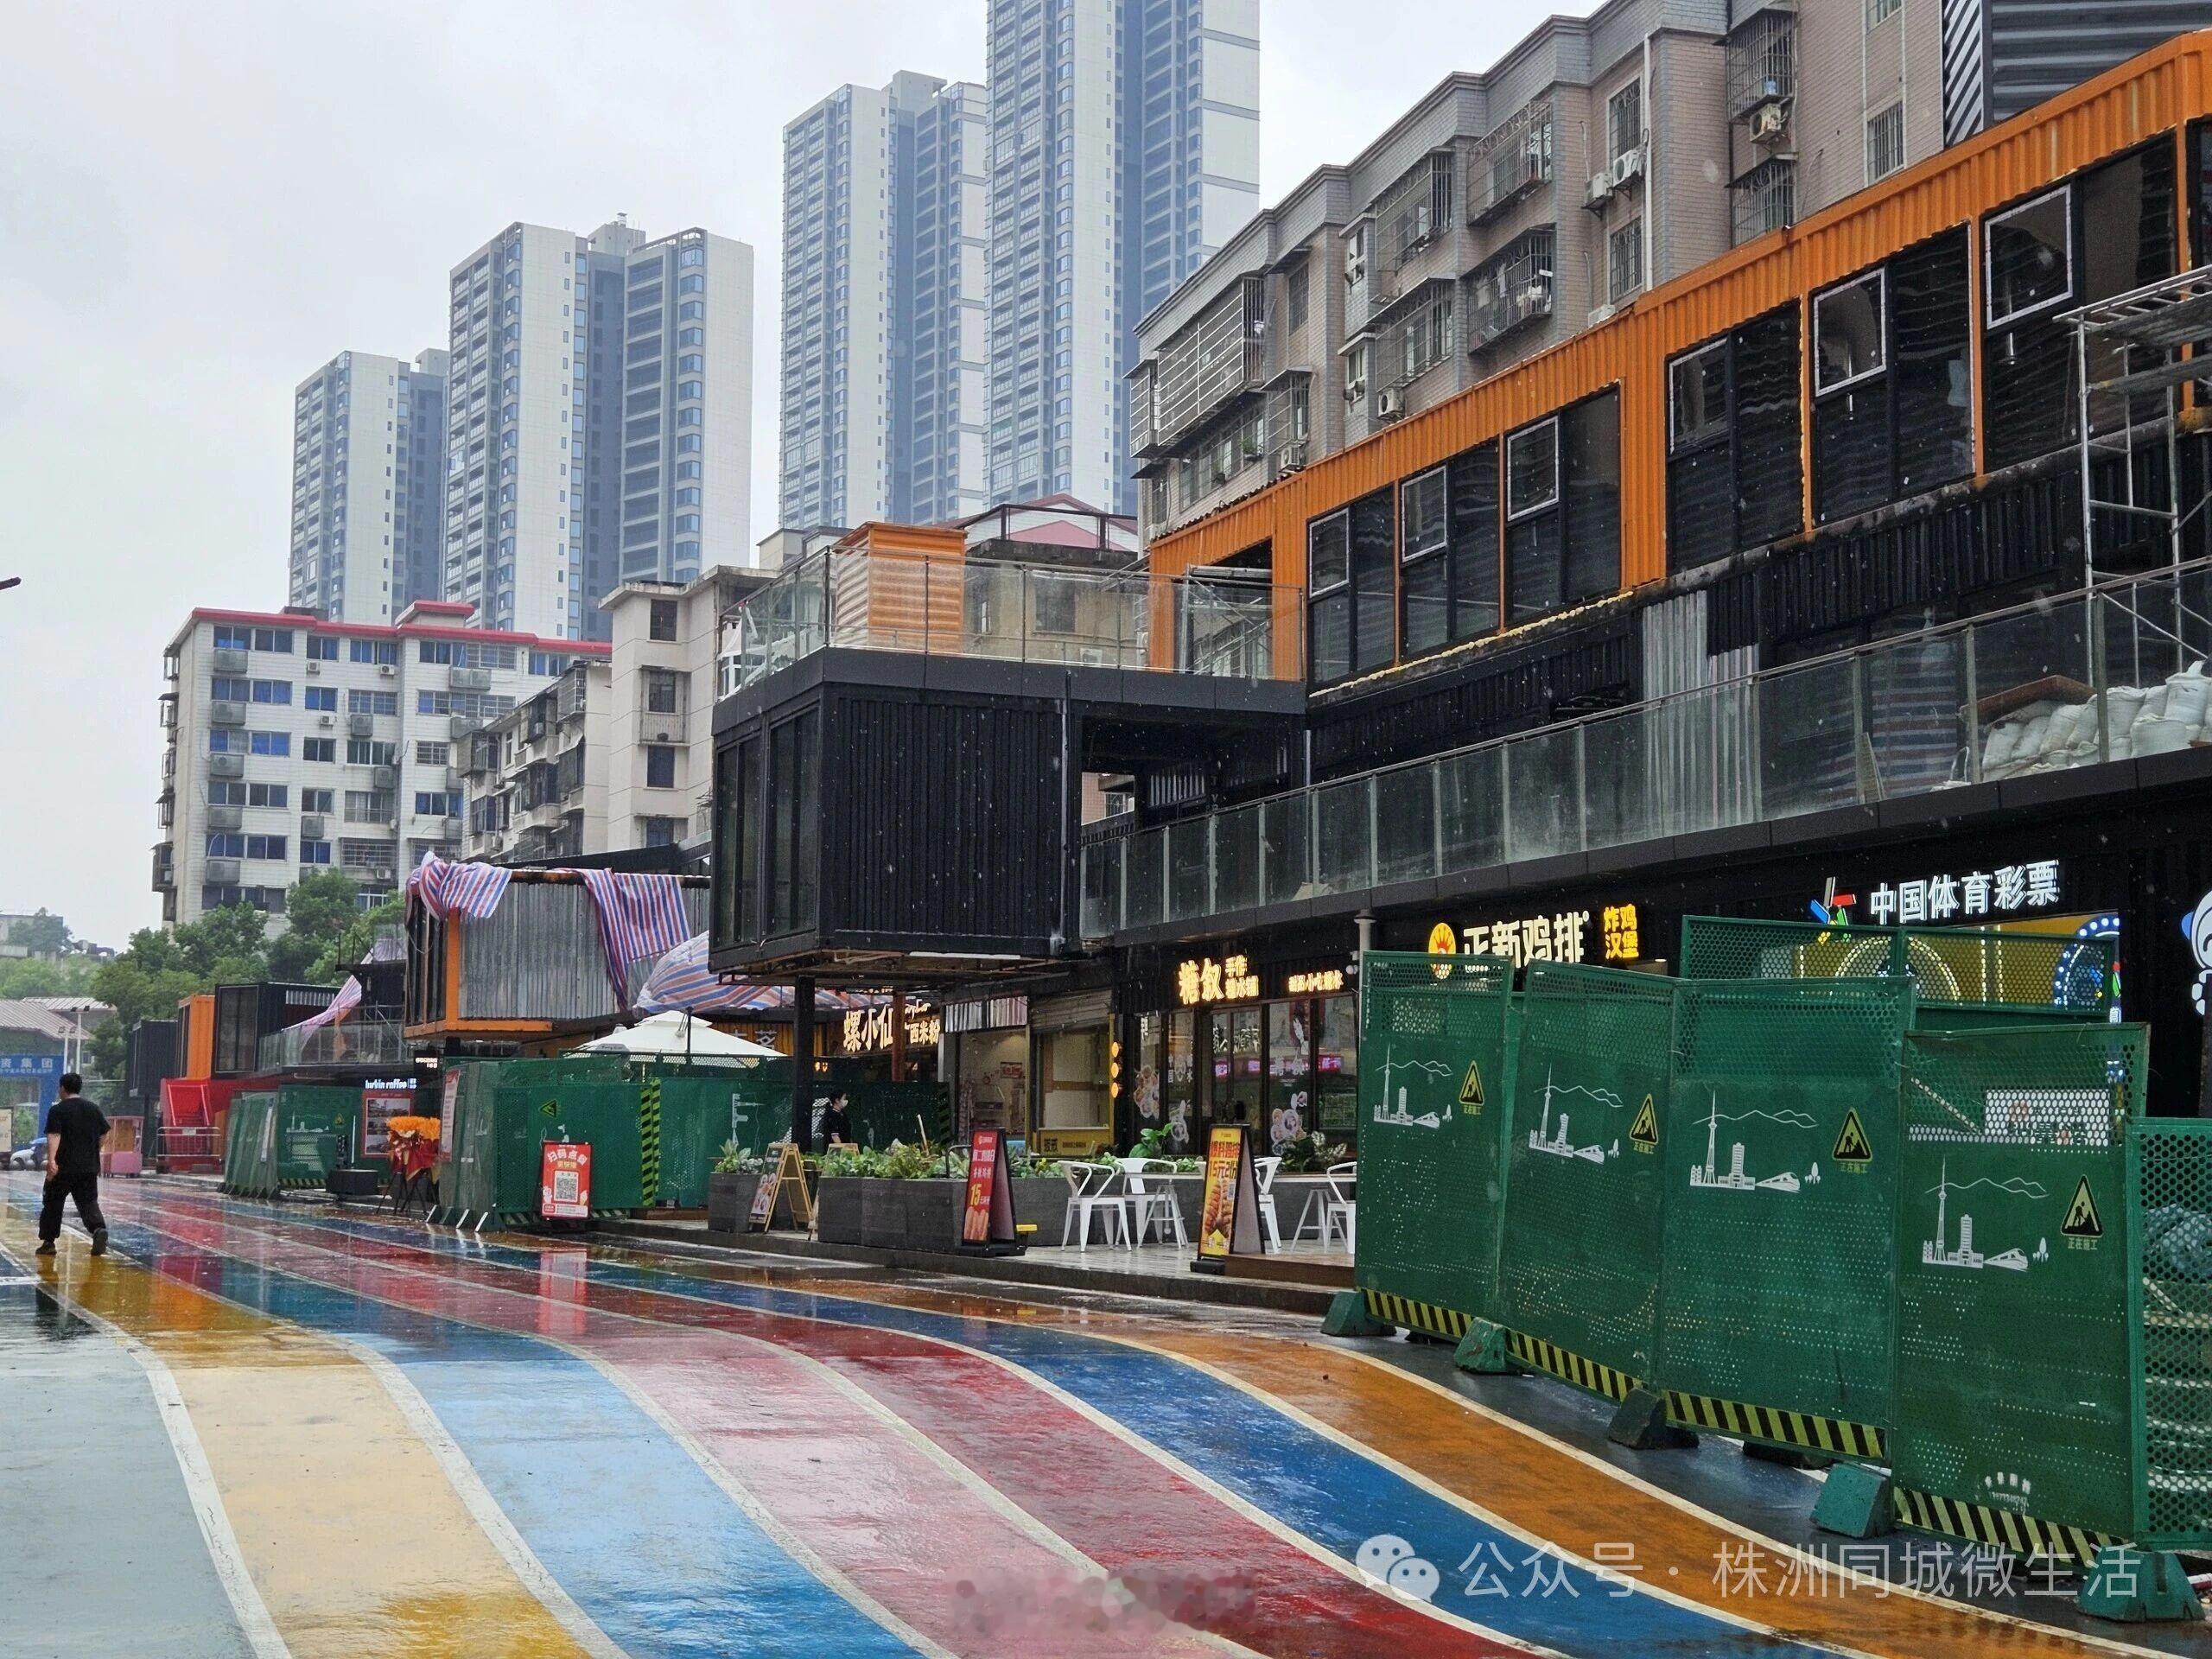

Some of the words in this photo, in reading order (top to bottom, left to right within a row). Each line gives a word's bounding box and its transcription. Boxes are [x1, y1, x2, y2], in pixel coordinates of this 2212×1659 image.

[1871, 860, 2060, 925] 中国体育彩票
[1604, 904, 1637, 932] 炸鸡
[1463, 910, 1585, 968] 正新鸡排
[1605, 931, 1639, 959] 汉堡
[905, 1019, 940, 1045] 西米粉
[1840, 1162, 1868, 1175] 正在施工
[2068, 1236, 2099, 1251] 正在施工
